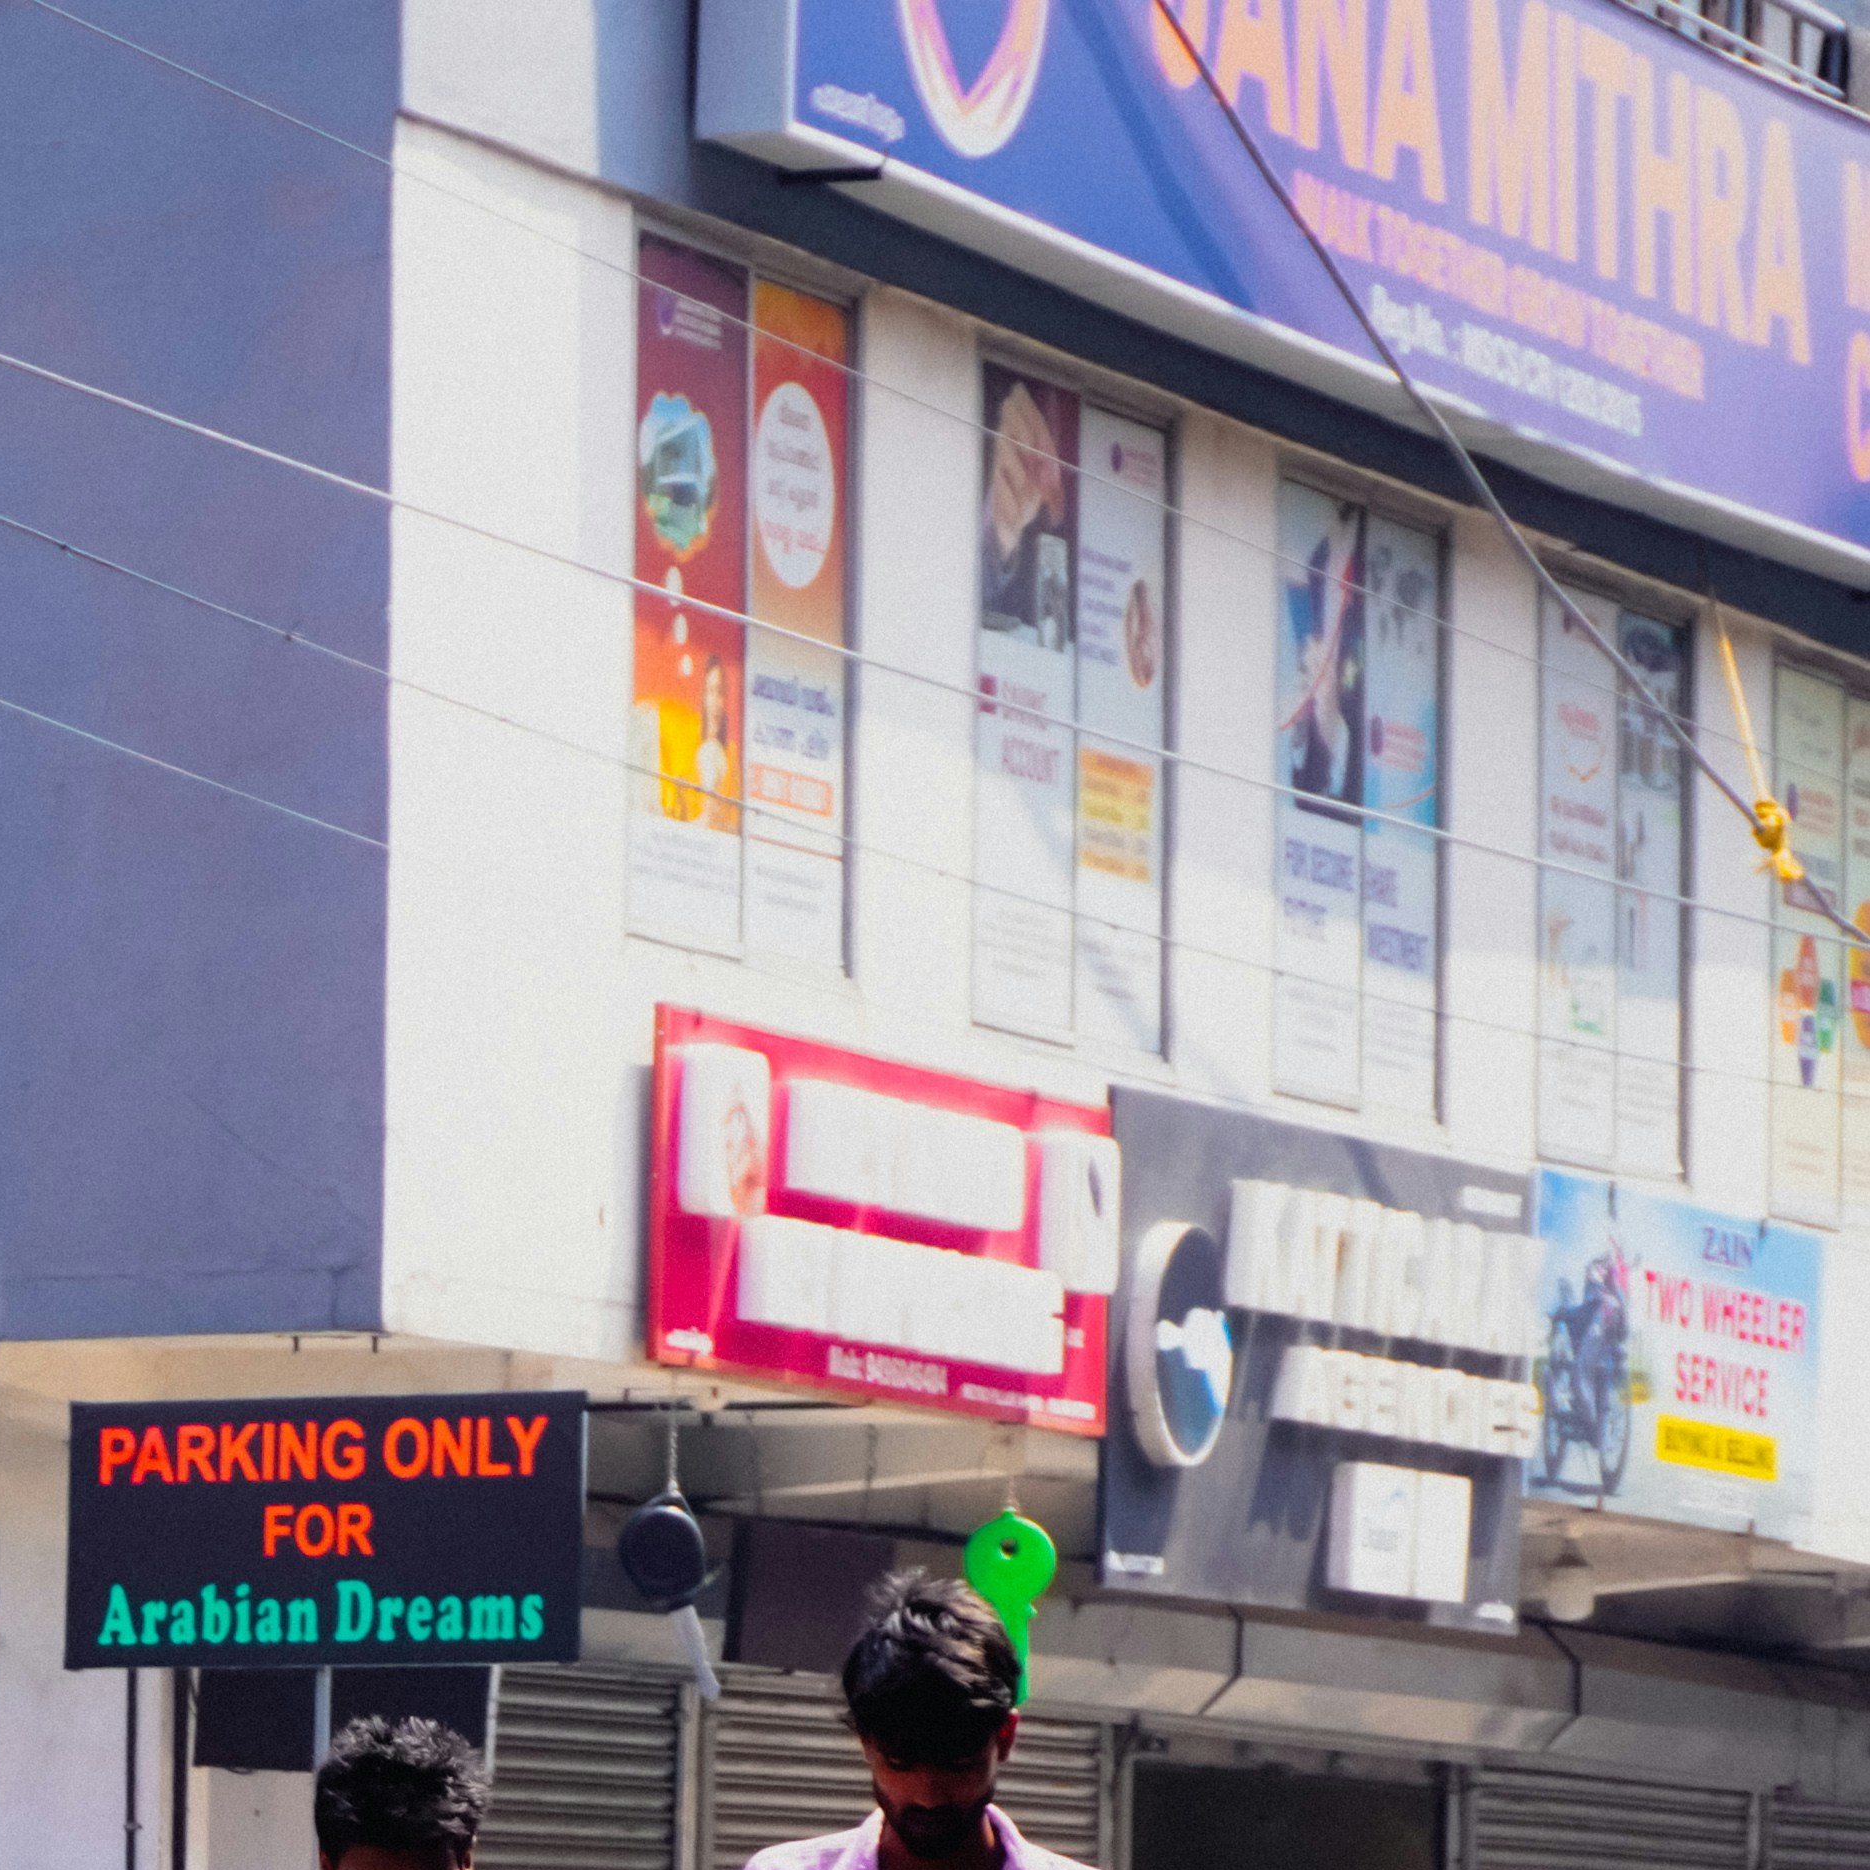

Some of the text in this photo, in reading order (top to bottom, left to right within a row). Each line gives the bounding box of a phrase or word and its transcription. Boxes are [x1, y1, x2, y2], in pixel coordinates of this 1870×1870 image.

[1467, 0, 1810, 366] MITHRA
[1702, 1226, 1754, 1268] ZAIN
[1645, 1268, 1806, 1357] TWO WHEELER
[1675, 1350, 1770, 1418] SERVICE
[98, 1414, 550, 1486] PARKING ONLY
[263, 1503, 375, 1558] FOR
[97, 1579, 545, 1647] Arabian Dreams
